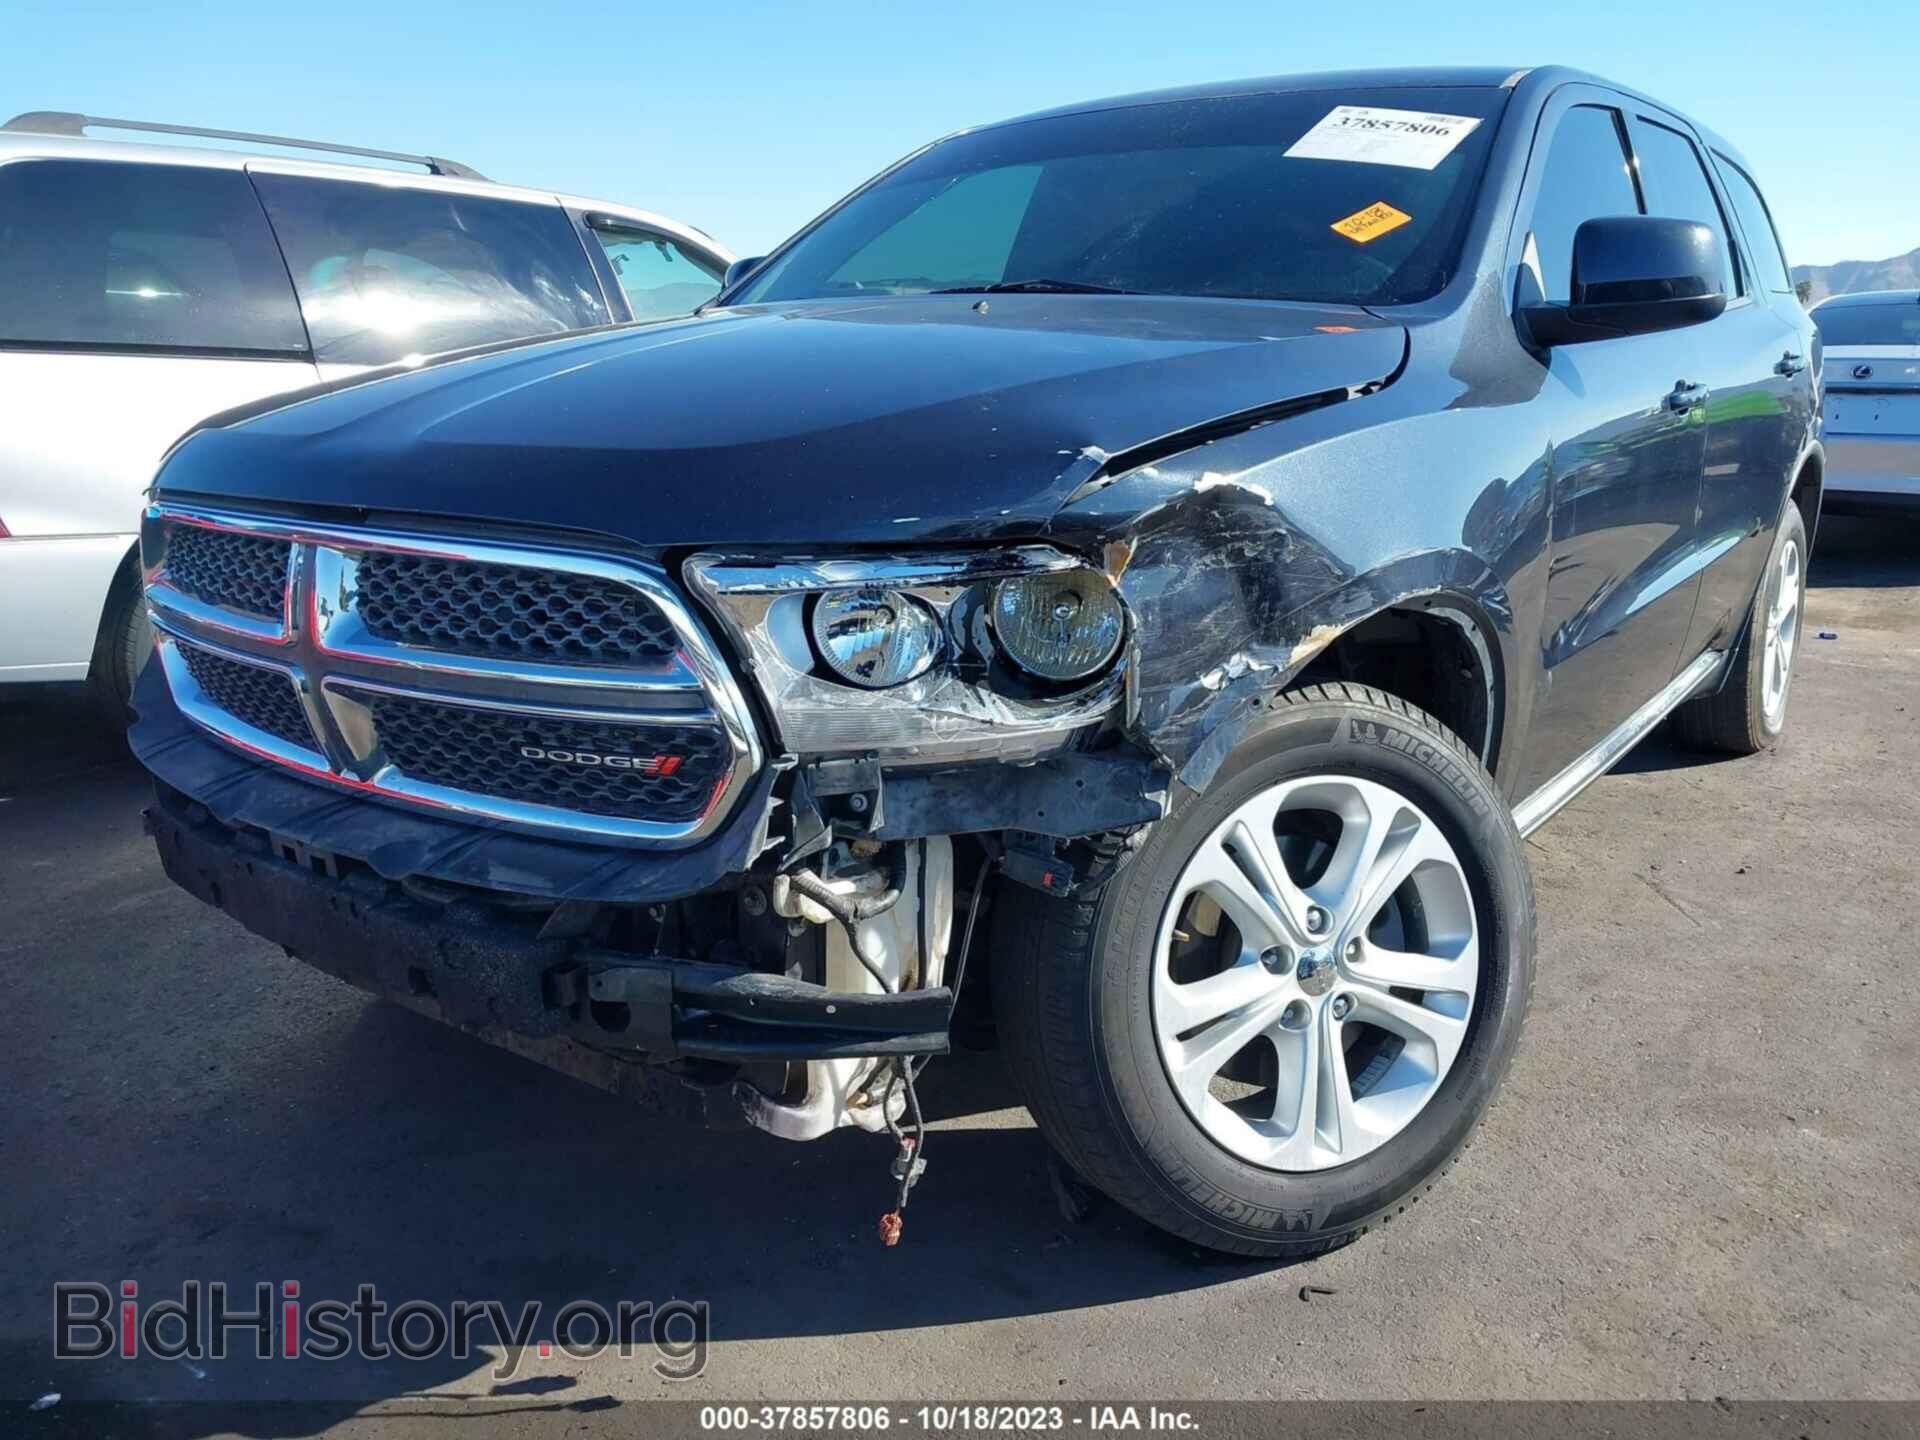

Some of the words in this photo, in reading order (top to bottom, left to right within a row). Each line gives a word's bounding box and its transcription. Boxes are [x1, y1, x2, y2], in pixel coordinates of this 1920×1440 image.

[1332, 116, 1450, 137] 37857806
[520, 746, 660, 771] DODGE
[1380, 727, 1490, 817] MICHELIN
